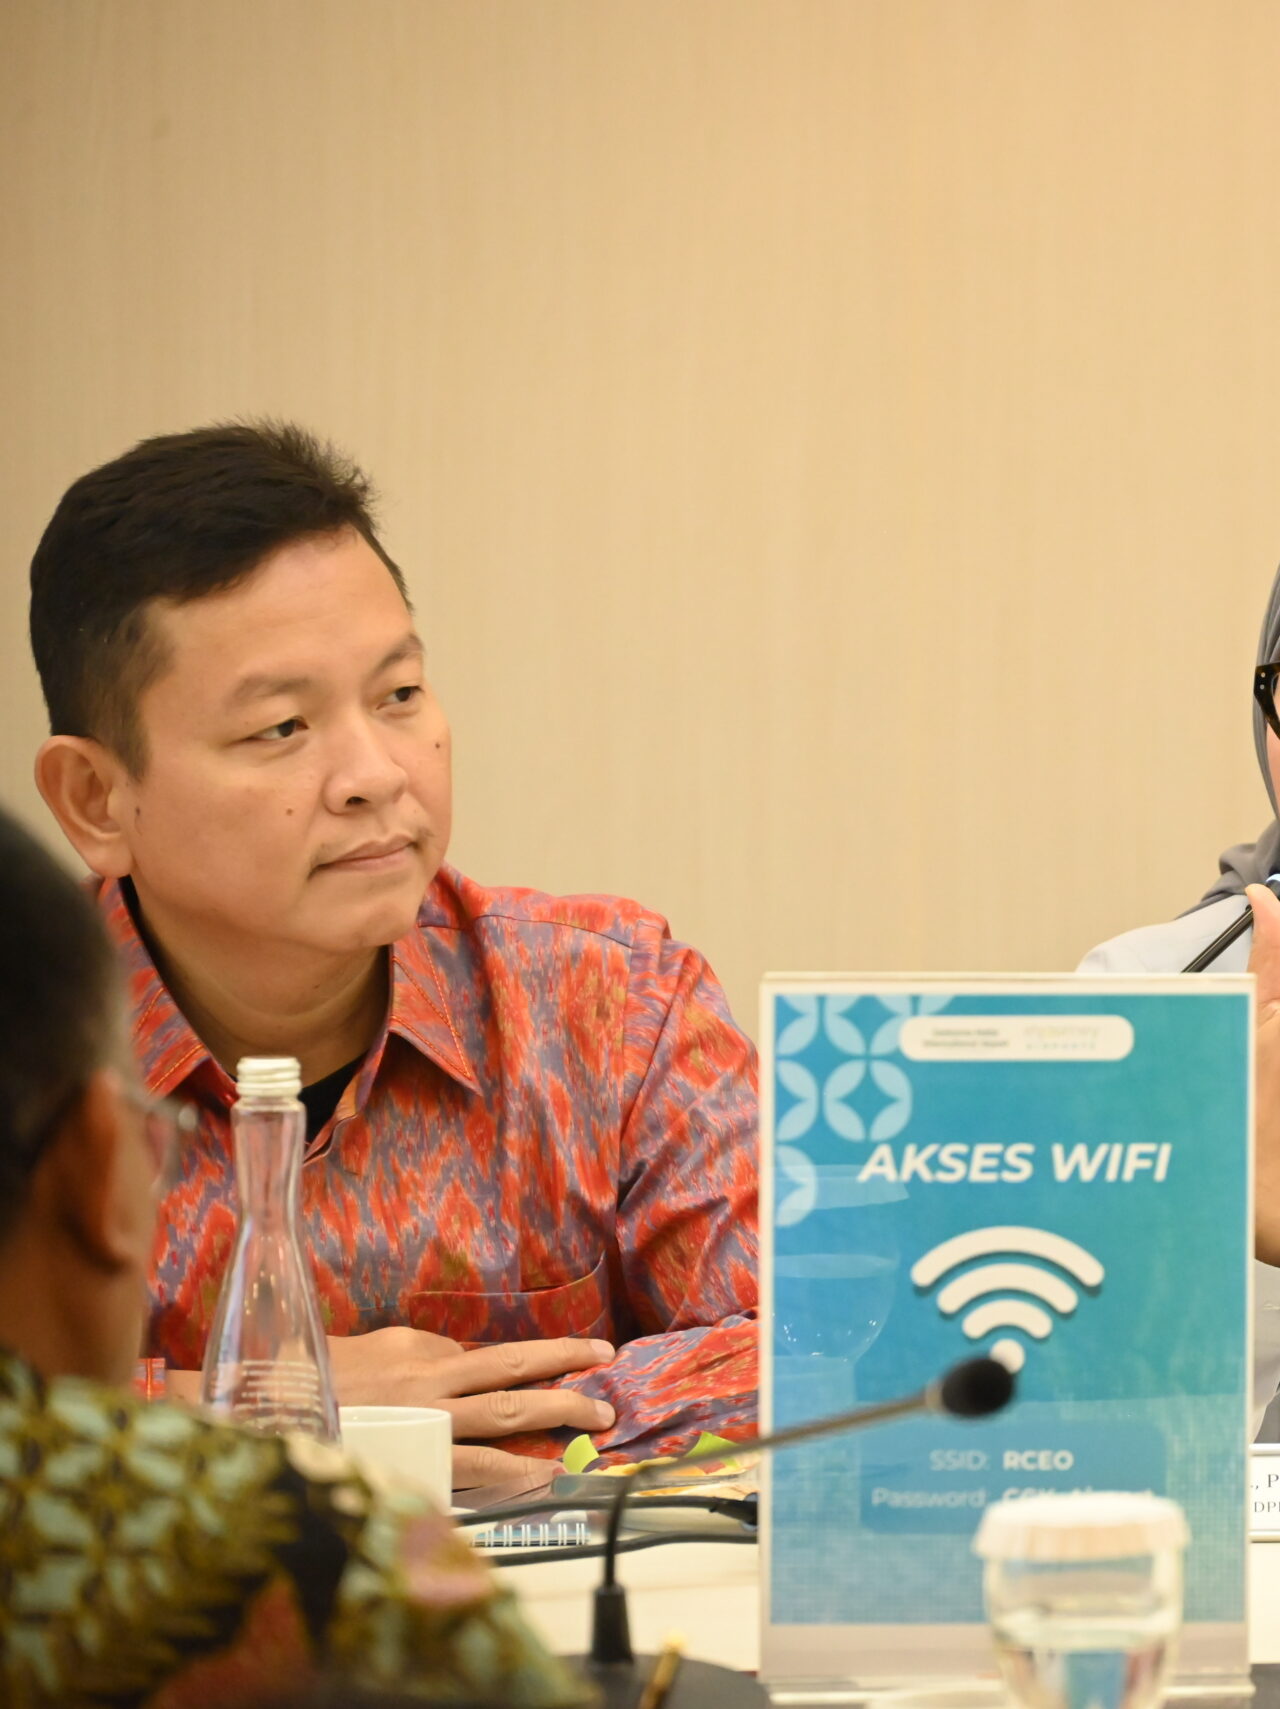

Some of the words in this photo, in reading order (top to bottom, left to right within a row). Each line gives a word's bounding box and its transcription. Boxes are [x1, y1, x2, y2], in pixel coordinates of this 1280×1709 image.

[857, 1142, 1035, 1183] AKSES
[1051, 1142, 1172, 1183] WIFI
[1003, 1450, 1074, 1471] RCEO
